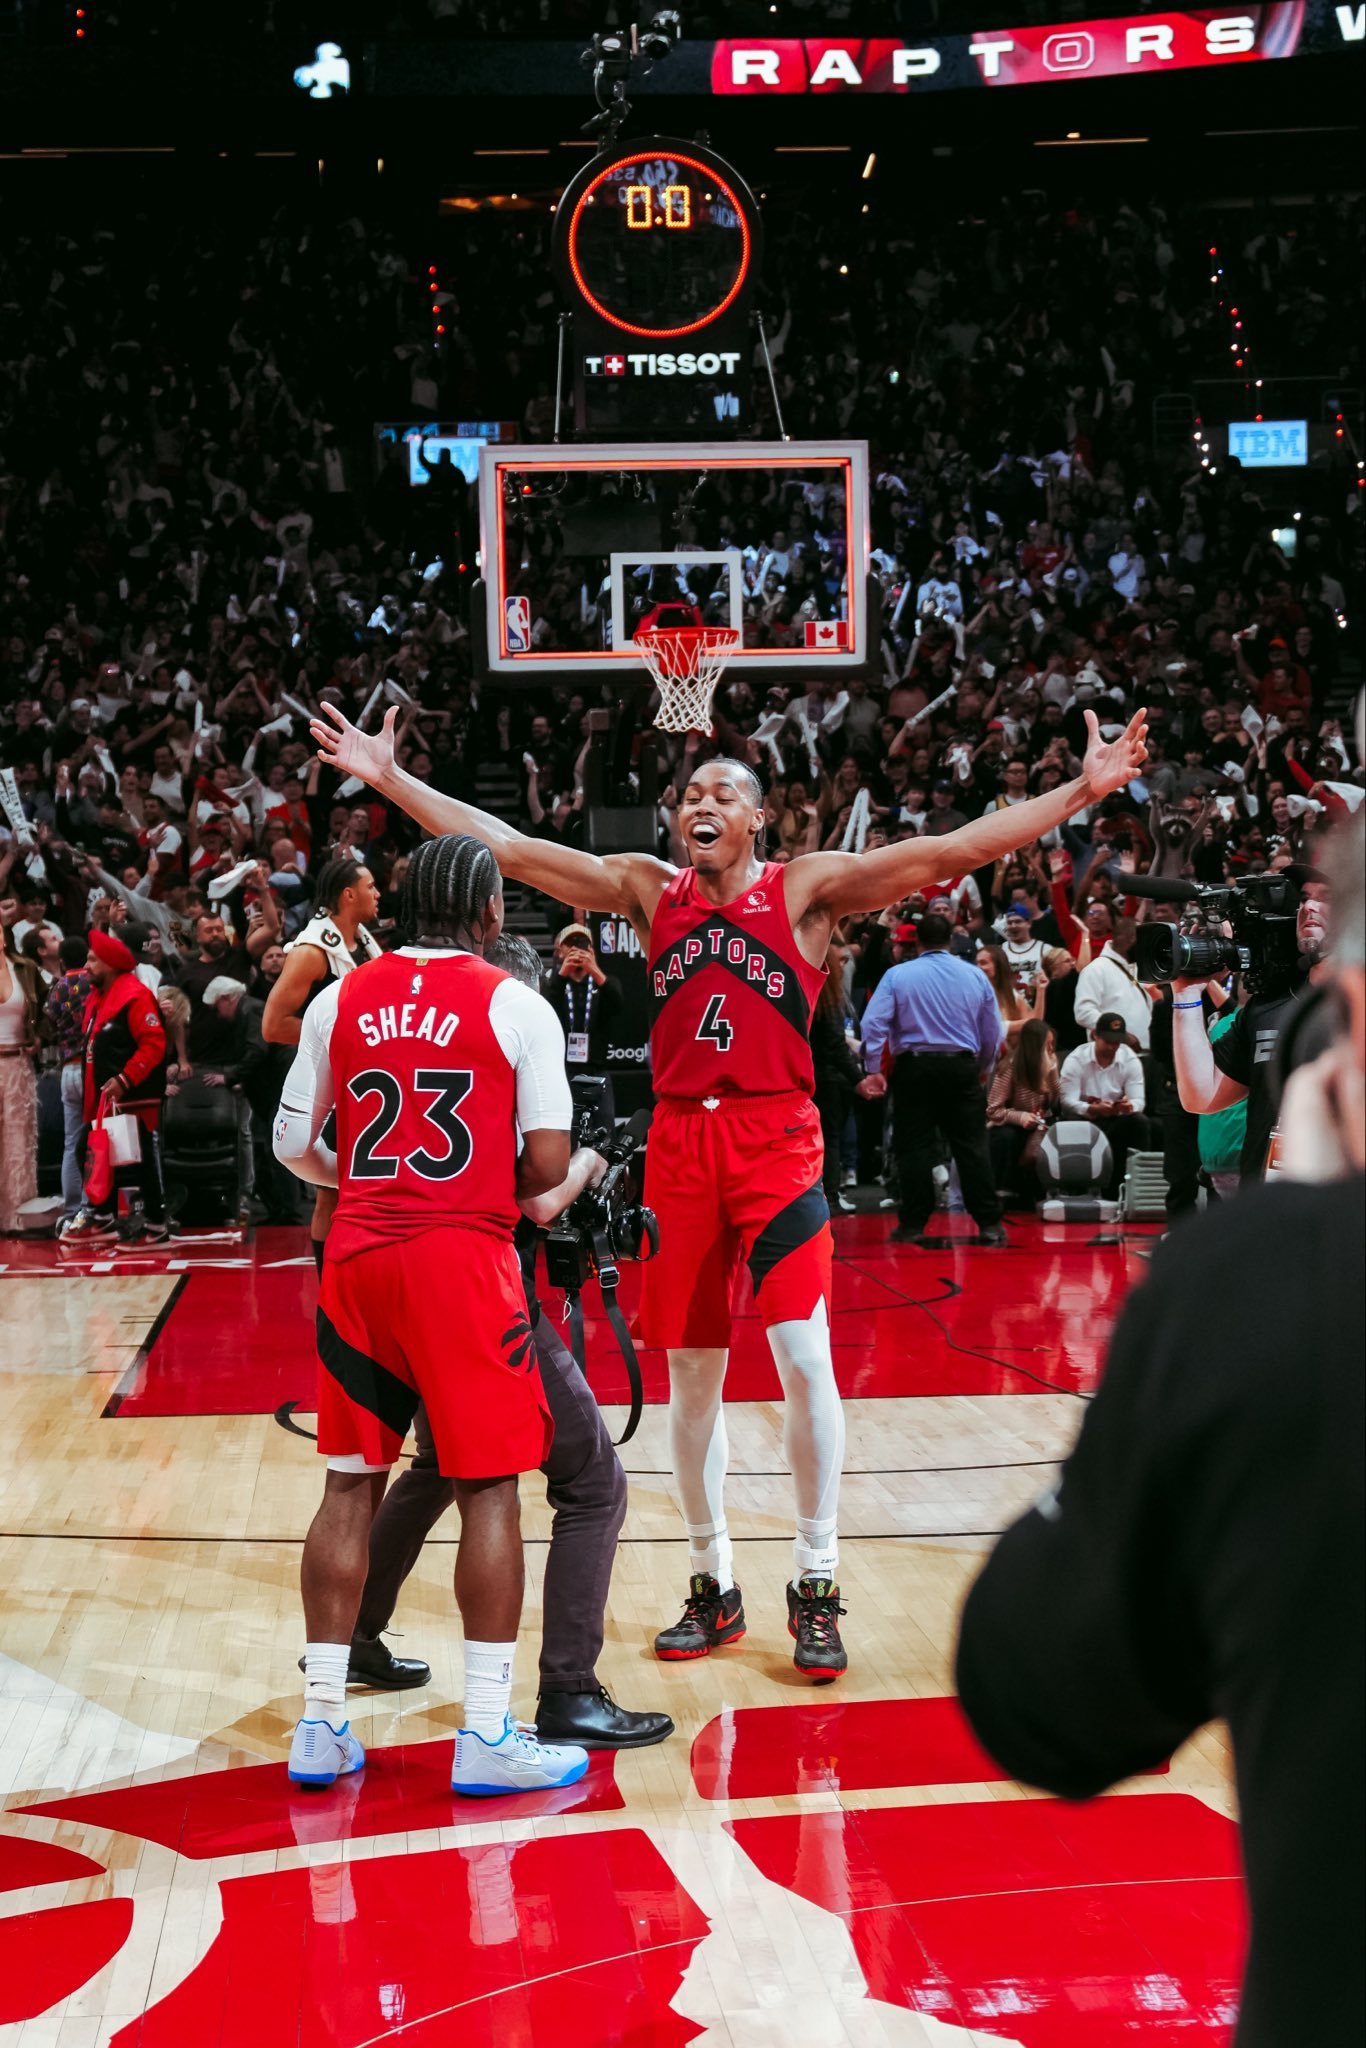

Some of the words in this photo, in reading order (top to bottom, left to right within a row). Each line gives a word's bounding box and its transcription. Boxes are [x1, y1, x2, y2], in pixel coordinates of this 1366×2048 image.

[732, 16, 1254, 84] RAPTORS
[627, 185, 690, 229] 0.0
[627, 352, 741, 376] TISSOT
[1235, 429, 1300, 458] IBM
[617, 921, 646, 958] Ap
[653, 928, 785, 998] RAPTORS
[357, 1003, 460, 1047] SHEAD
[694, 994, 733, 1051] 4
[347, 1068, 474, 1181] 23
